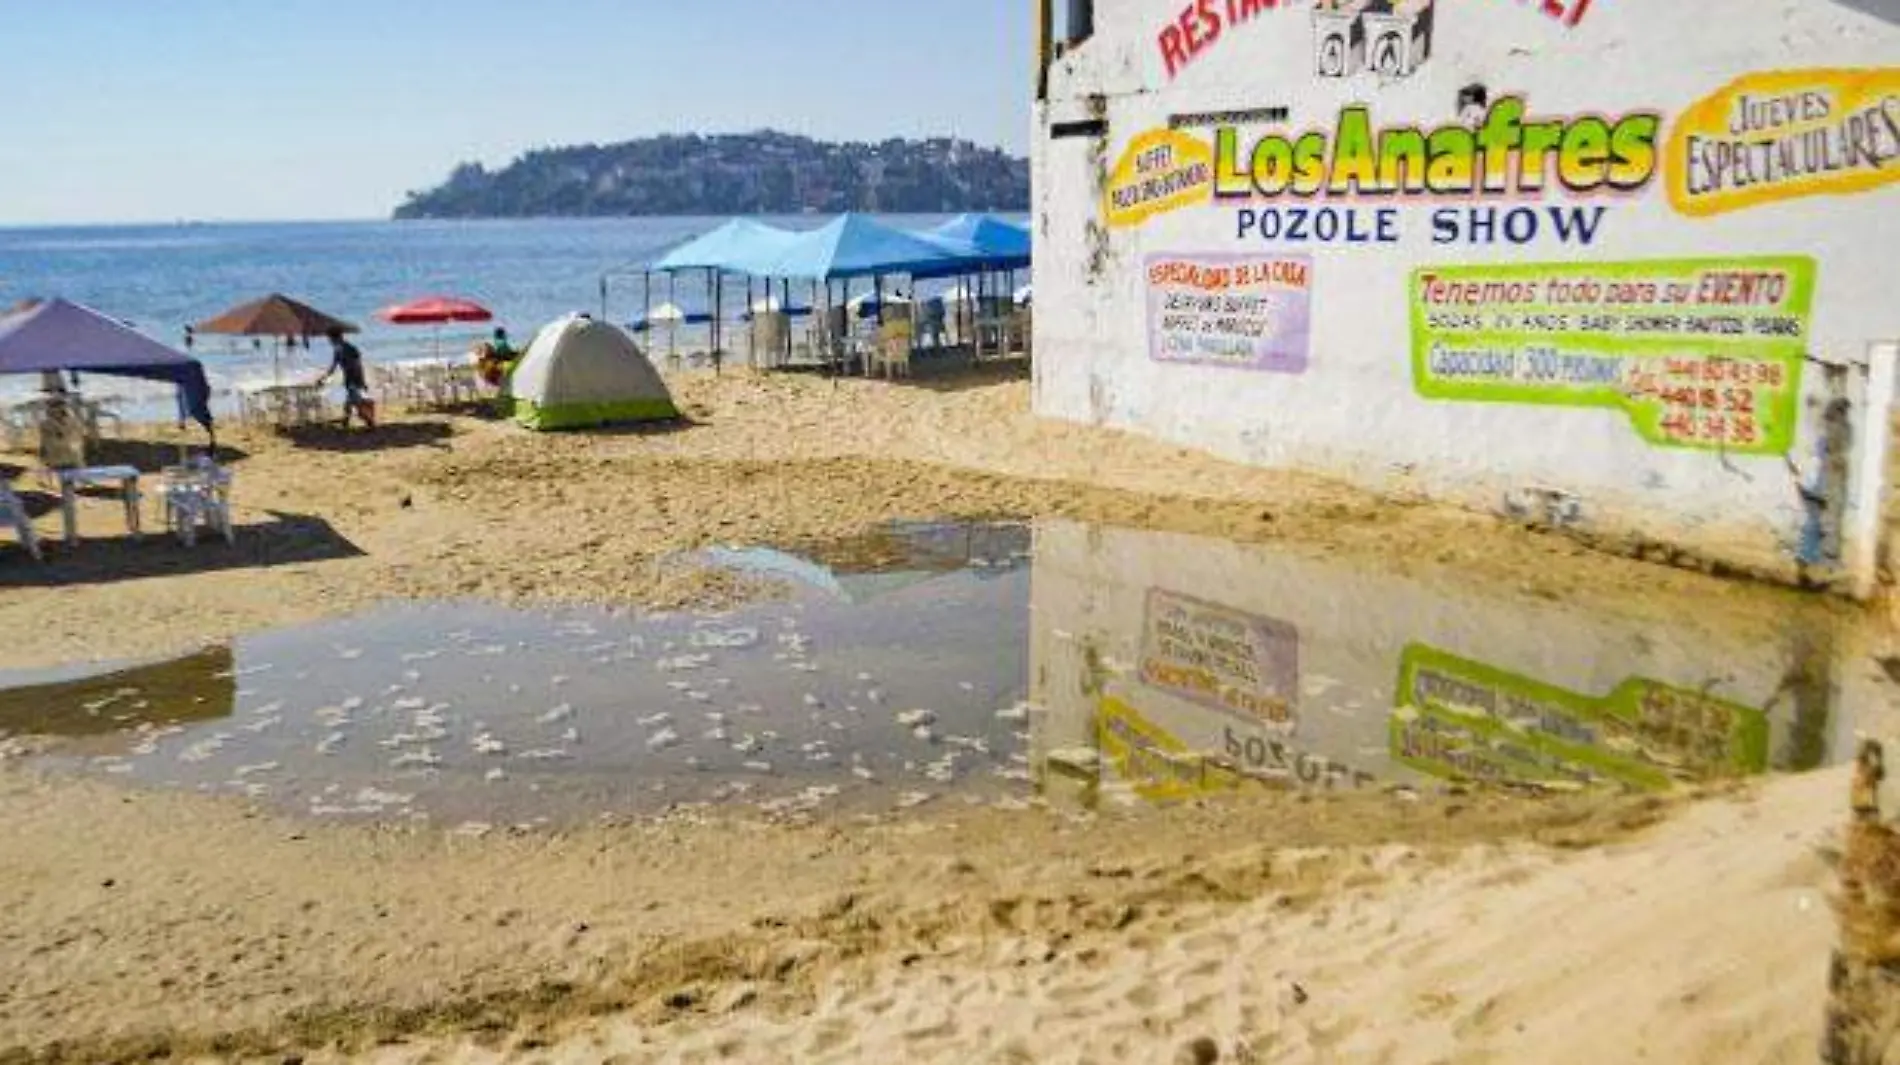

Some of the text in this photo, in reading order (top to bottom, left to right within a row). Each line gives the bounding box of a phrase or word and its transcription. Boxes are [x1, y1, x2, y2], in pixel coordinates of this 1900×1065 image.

[1214, 128, 1325, 198] Los
[1326, 94, 1661, 196] Anafres
[1237, 205, 1606, 244] POZOLE SHOW
[1421, 274, 1536, 305] Tenemos
[1547, 279, 1599, 305] todo
[1698, 271, 1786, 305] EVENTO
